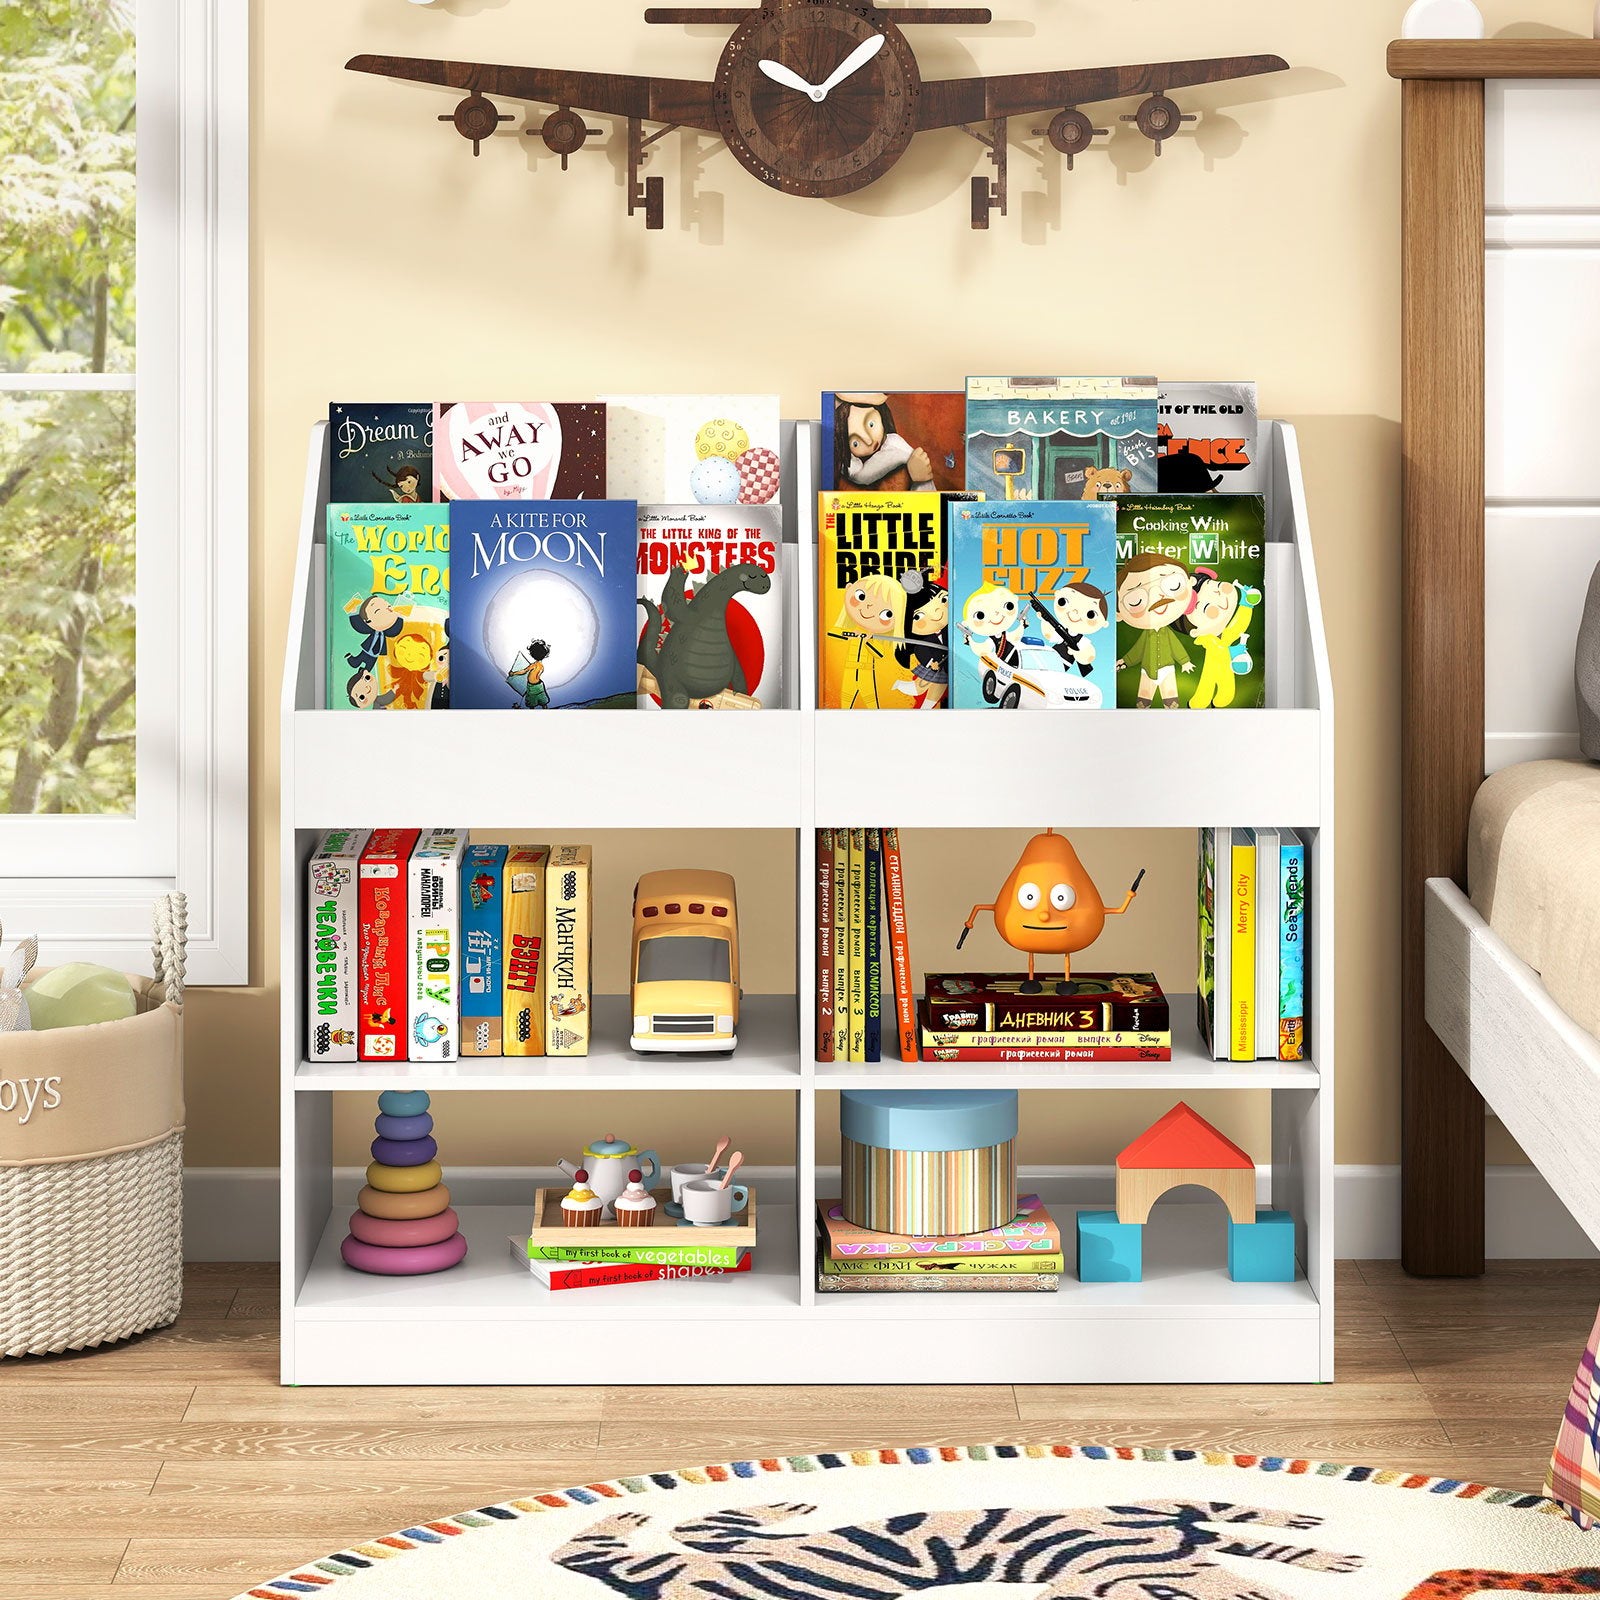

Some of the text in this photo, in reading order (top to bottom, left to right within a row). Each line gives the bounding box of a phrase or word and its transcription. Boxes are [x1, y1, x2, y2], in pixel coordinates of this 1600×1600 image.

[809, 10, 826, 22] 12
[729, 41, 741, 51] 50
[763, 170, 775, 180] 35
[488, 411, 509, 426] and
[1007, 410, 1104, 426] BAKERY
[1157, 405, 1244, 414] IT OF THE OLD
[337, 416, 419, 459] Dream
[462, 422, 545, 463] AWAY
[498, 449, 516, 460] we
[1126, 446, 1155, 467] BIS
[488, 456, 532, 483] GO
[490, 513, 588, 528] A KITE FOR
[825, 512, 835, 529] THE
[836, 513, 935, 549] LITTLE
[1133, 516, 1229, 533] Cooking With
[334, 531, 355, 545] The
[640, 528, 761, 539] THE LITTLE KING OF THE
[470, 530, 607, 579] MOON
[982, 528, 1090, 567] HOT
[1116, 539, 1260, 559] Mister White
[868, 861, 876, 911] коллекция
[889, 854, 905, 934] СТРАННОГЕДДОН
[1237, 873, 1250, 934] Merry City
[1285, 857, 1299, 942] Sea Friends
[372, 887, 391, 1006] Коварный Лис
[553, 907, 577, 988] Манчкин
[867, 915, 876, 957] коротких
[316, 900, 338, 1015] ЧЕЛОВЕЧКИ
[425, 929, 451, 1006] ГРОГУ
[507, 934, 541, 993] БЭНГ!
[820, 969, 829, 1003] выпуск
[836, 968, 845, 1002] выпуск
[851, 970, 861, 1003] выпуск
[869, 961, 879, 1018] КОМИКСОВ
[822, 1007, 832, 1016] 2
[838, 1006, 847, 1014] 5
[1000, 1010, 1094, 1029] ДНЕВНИК 3
[1238, 1000, 1248, 1052] Mississippi
[1287, 1019, 1296, 1045] Earth
[821, 1029, 832, 1052] Disney
[836, 1028, 847, 1051] Disney
[852, 1029, 863, 1052] Disney
[1077, 1036, 1111, 1047] выпуск
[1115, 1033, 1122, 1043] 6
[1137, 1034, 1160, 1044] Disney
[0, 1076, 62, 1125] oys
[565, 1248, 730, 1265] my first book of vegetables
[836, 1238, 1053, 1255] РАСКРАСКА
[588, 1264, 724, 1285] my first book of shapes
